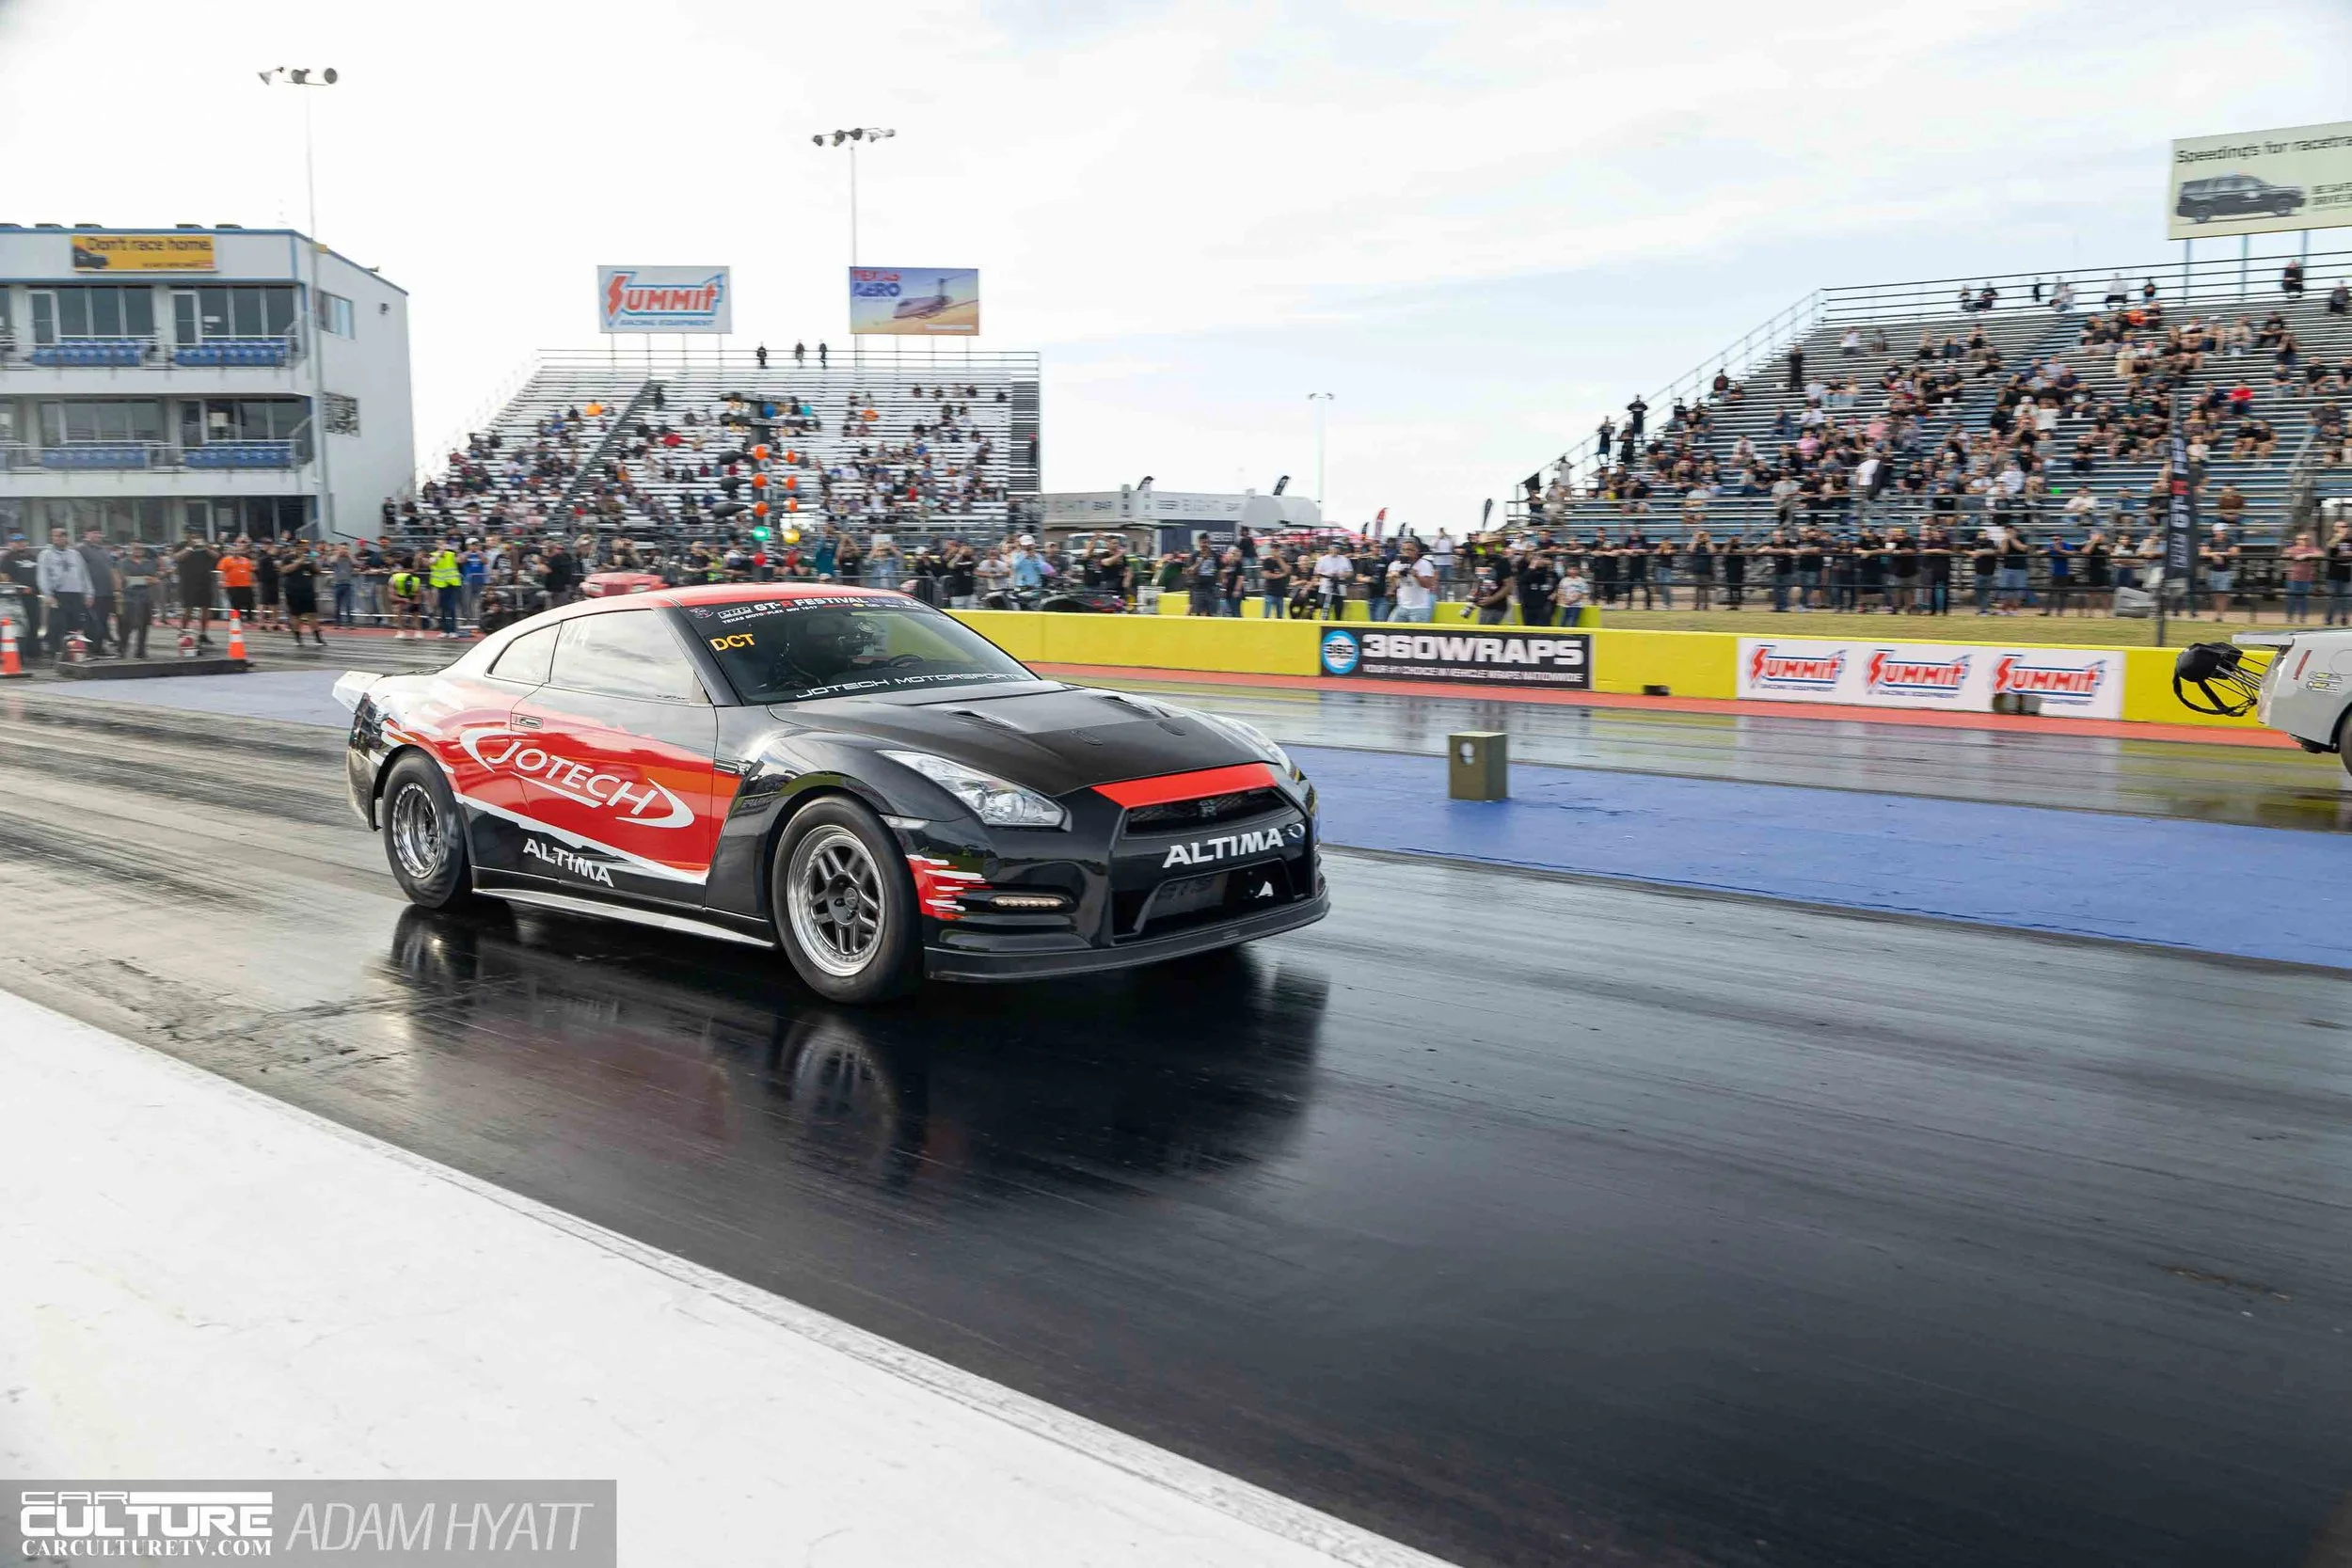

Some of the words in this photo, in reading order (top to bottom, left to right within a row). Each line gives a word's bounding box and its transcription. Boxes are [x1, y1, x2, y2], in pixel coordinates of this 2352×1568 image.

[2264, 141, 2288, 154] for
[87, 236, 128, 251] Don't
[131, 240, 165, 251] race
[754, 599, 795, 611] GT-R
[793, 595, 868, 608] FESTIVAL
[722, 616, 745, 625] TEXAS
[709, 633, 755, 652] DCT
[1362, 634, 1584, 666] 360WRAPS
[1403, 666, 1438, 676] CHOICE
[1448, 668, 1486, 678] VEHICLE
[1488, 670, 1520, 679] WRAPS
[1521, 672, 1584, 682] NATIONWIDE
[796, 678, 889, 699] JOTECH
[895, 673, 1026, 686] MOTORSPORTS
[485, 740, 659, 816] JOTECH
[1162, 828, 1285, 868] ALTIMA
[523, 838, 615, 888] ALTIMA
